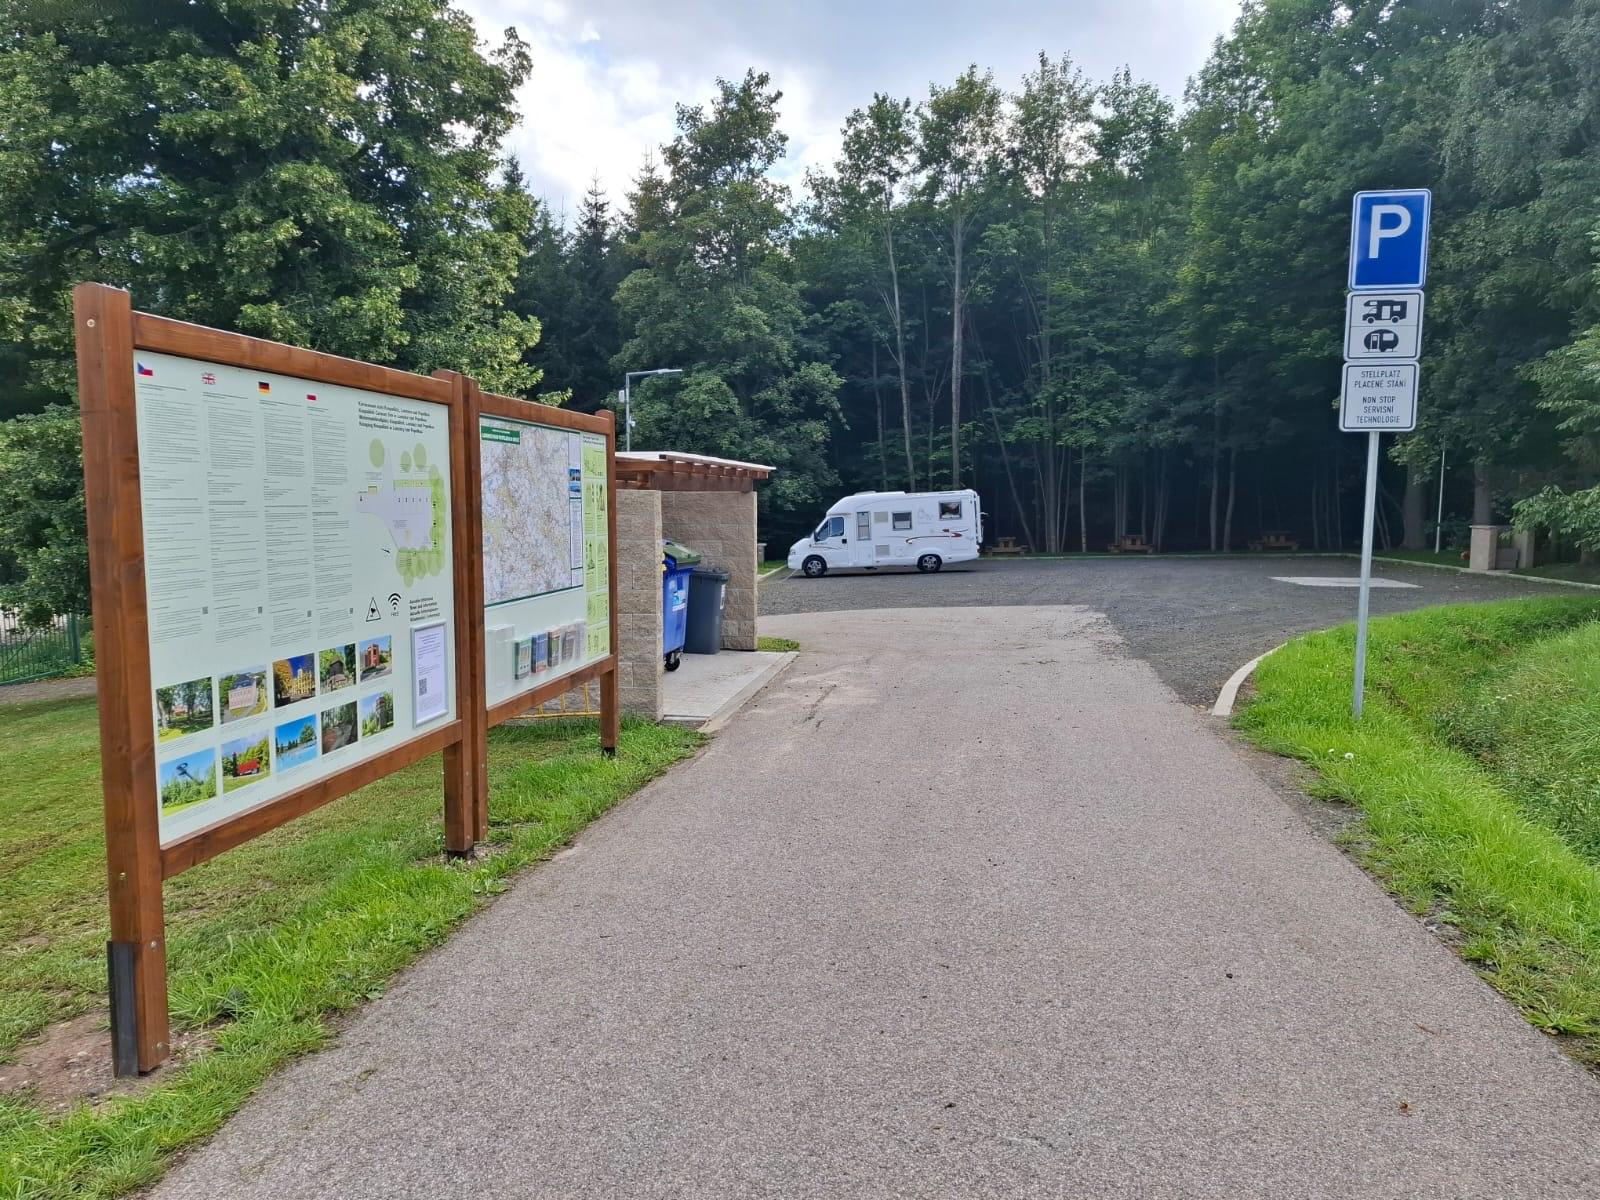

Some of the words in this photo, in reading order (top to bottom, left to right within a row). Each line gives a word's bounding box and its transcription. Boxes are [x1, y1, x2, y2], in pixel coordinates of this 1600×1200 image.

[1368, 204, 1412, 259] P
[1361, 370, 1401, 378] STELLPLATZ
[1363, 396, 1377, 404] NON
[1380, 396, 1396, 404] STOP
[1357, 416, 1400, 424] TECHNOLOGIE
